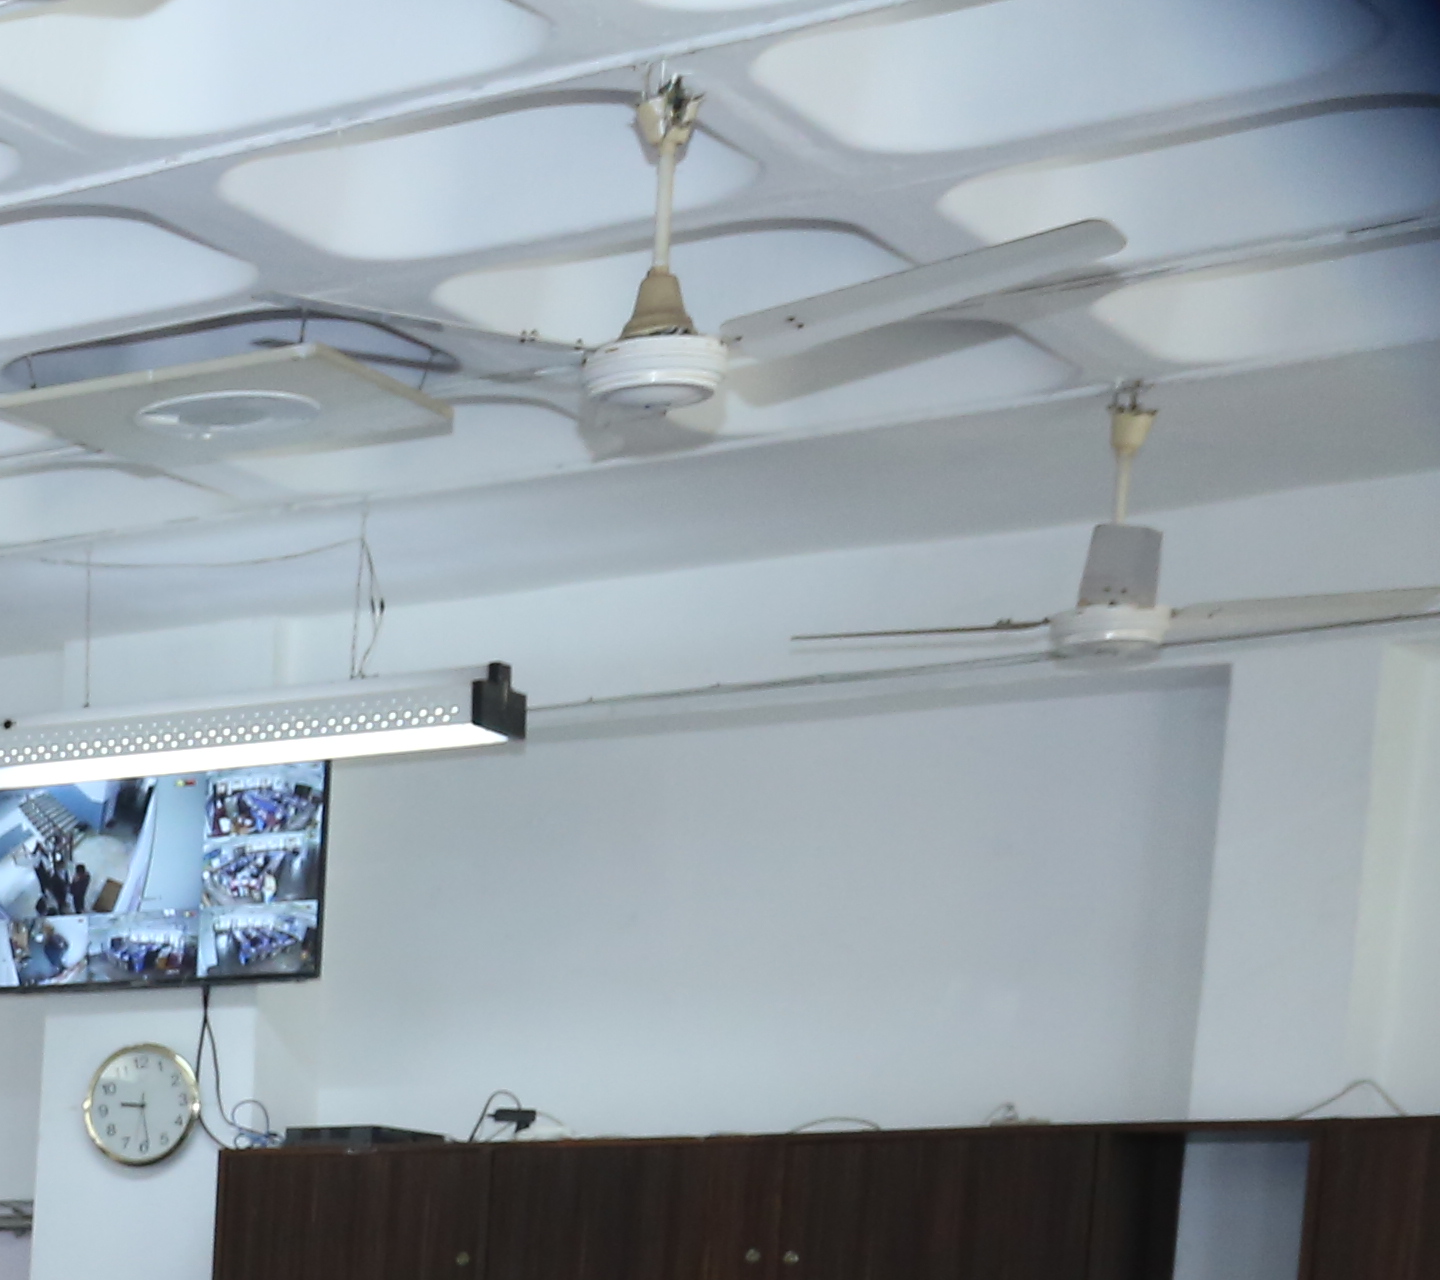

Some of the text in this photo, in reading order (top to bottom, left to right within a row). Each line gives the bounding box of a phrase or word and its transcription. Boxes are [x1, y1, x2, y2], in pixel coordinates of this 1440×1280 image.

[135, 1057, 148, 1068] 12
[171, 1073, 181, 1086] 2
[103, 1082, 116, 1095] 10
[98, 1105, 108, 1118] 9
[107, 1124, 116, 1136] 8
[122, 1136, 130, 1149] 7
[161, 1133, 168, 1145] 5
